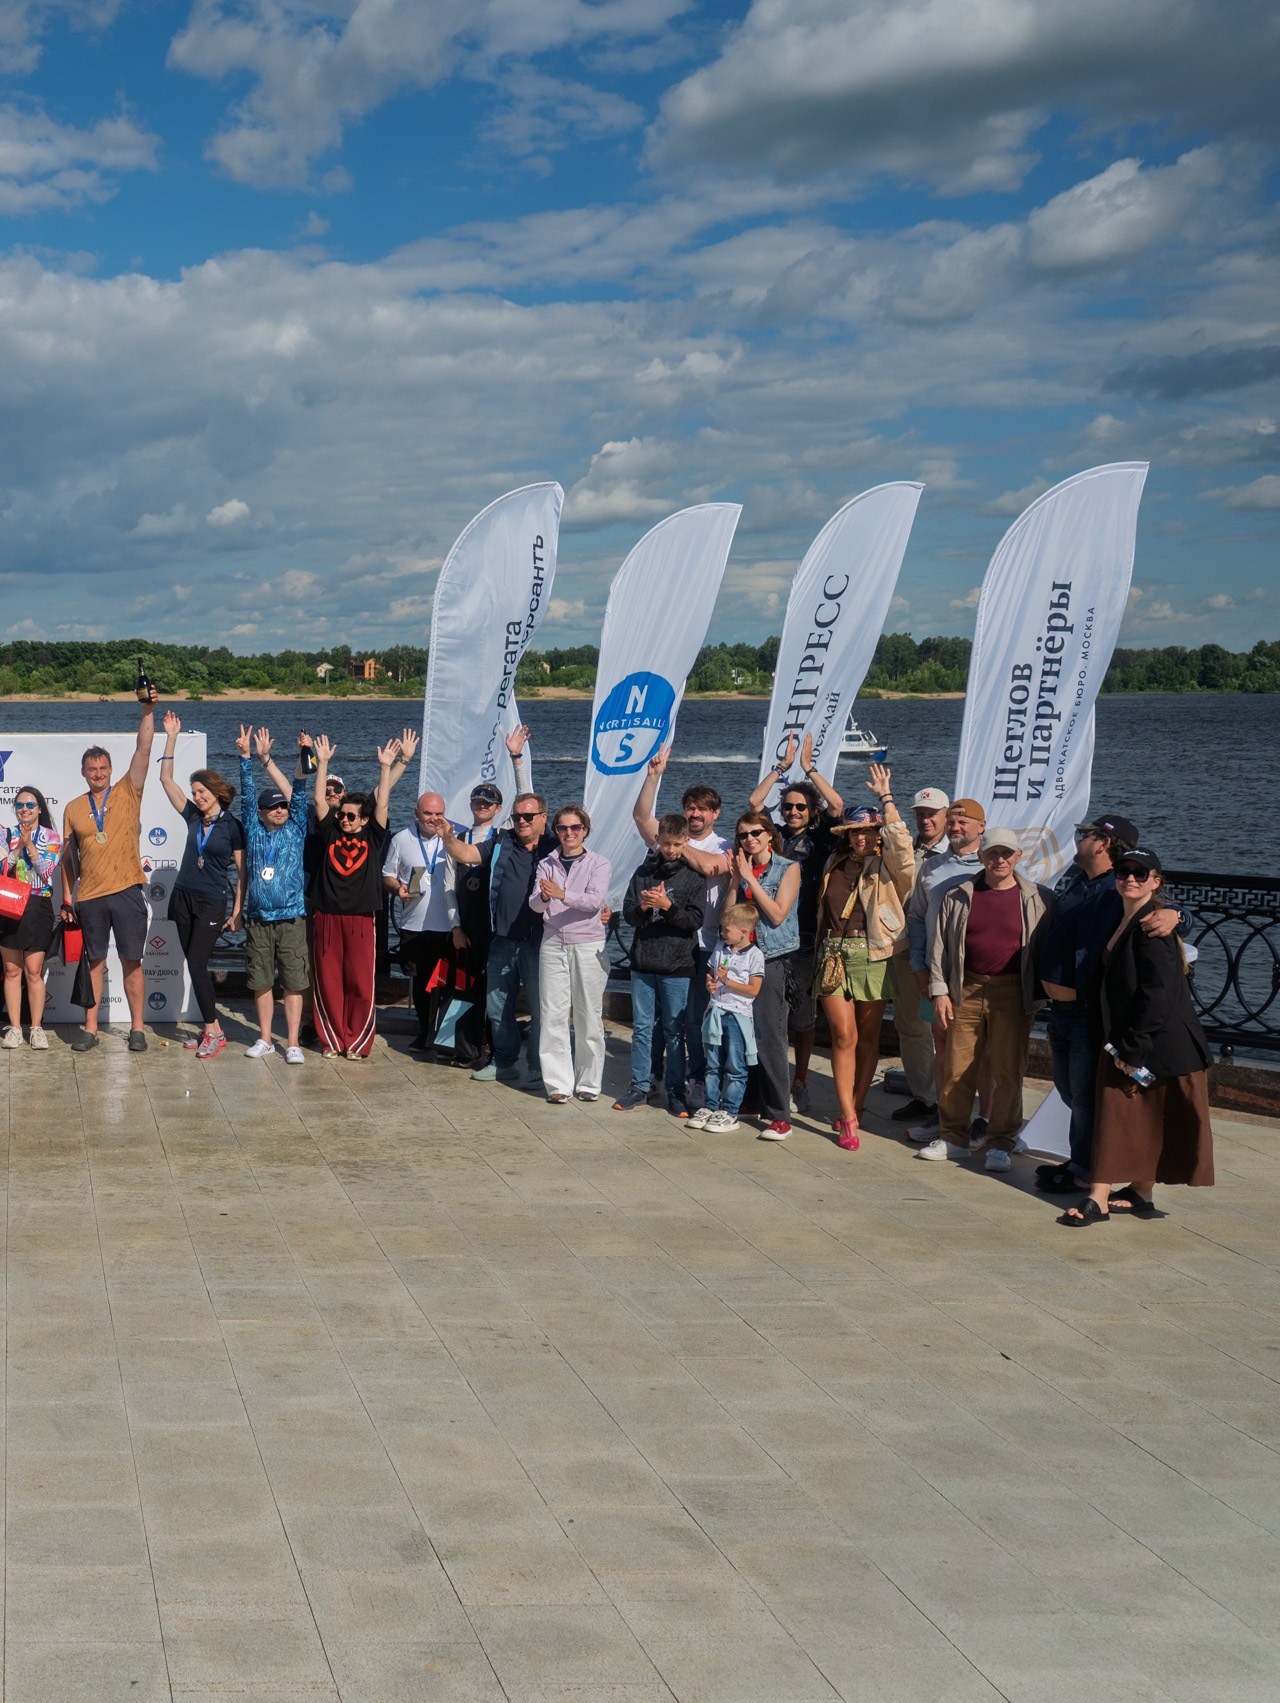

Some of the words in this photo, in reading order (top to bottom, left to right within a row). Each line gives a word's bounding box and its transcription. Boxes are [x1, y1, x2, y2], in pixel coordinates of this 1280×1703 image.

[521, 534, 545, 647] ерсантъ
[625, 685, 649, 714] N
[775, 573, 850, 772] ОНГРЕСС
[1029, 580, 1074, 767] партнёры
[1055, 711, 1079, 800] АДВОКАТСКОЕ
[1081, 606, 1095, 660] МОСКВА
[614, 732, 636, 762] S
[992, 662, 1033, 803] Щеглов
[1026, 778, 1046, 801] и
[152, 860, 178, 869] ТПЭ
